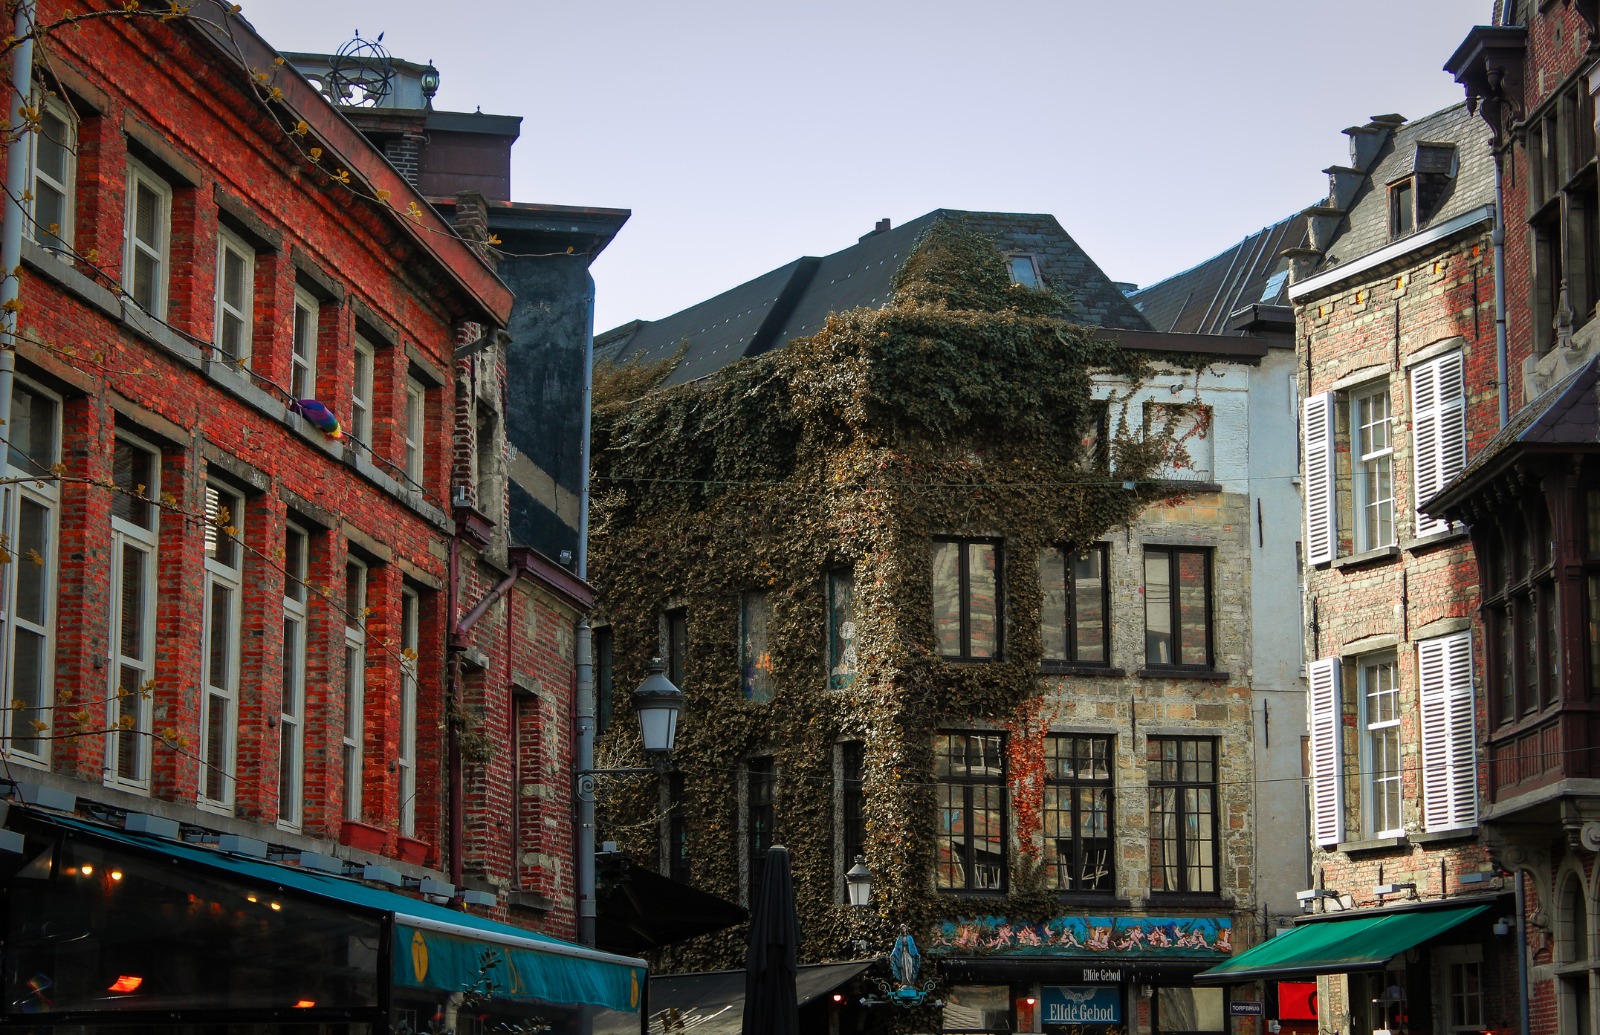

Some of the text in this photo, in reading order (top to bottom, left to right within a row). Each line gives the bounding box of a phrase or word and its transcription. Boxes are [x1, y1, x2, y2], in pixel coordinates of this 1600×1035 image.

[1083, 969, 1121, 981] Elfde Gebod
[1050, 1003, 1114, 1021] Elfde Gebod
